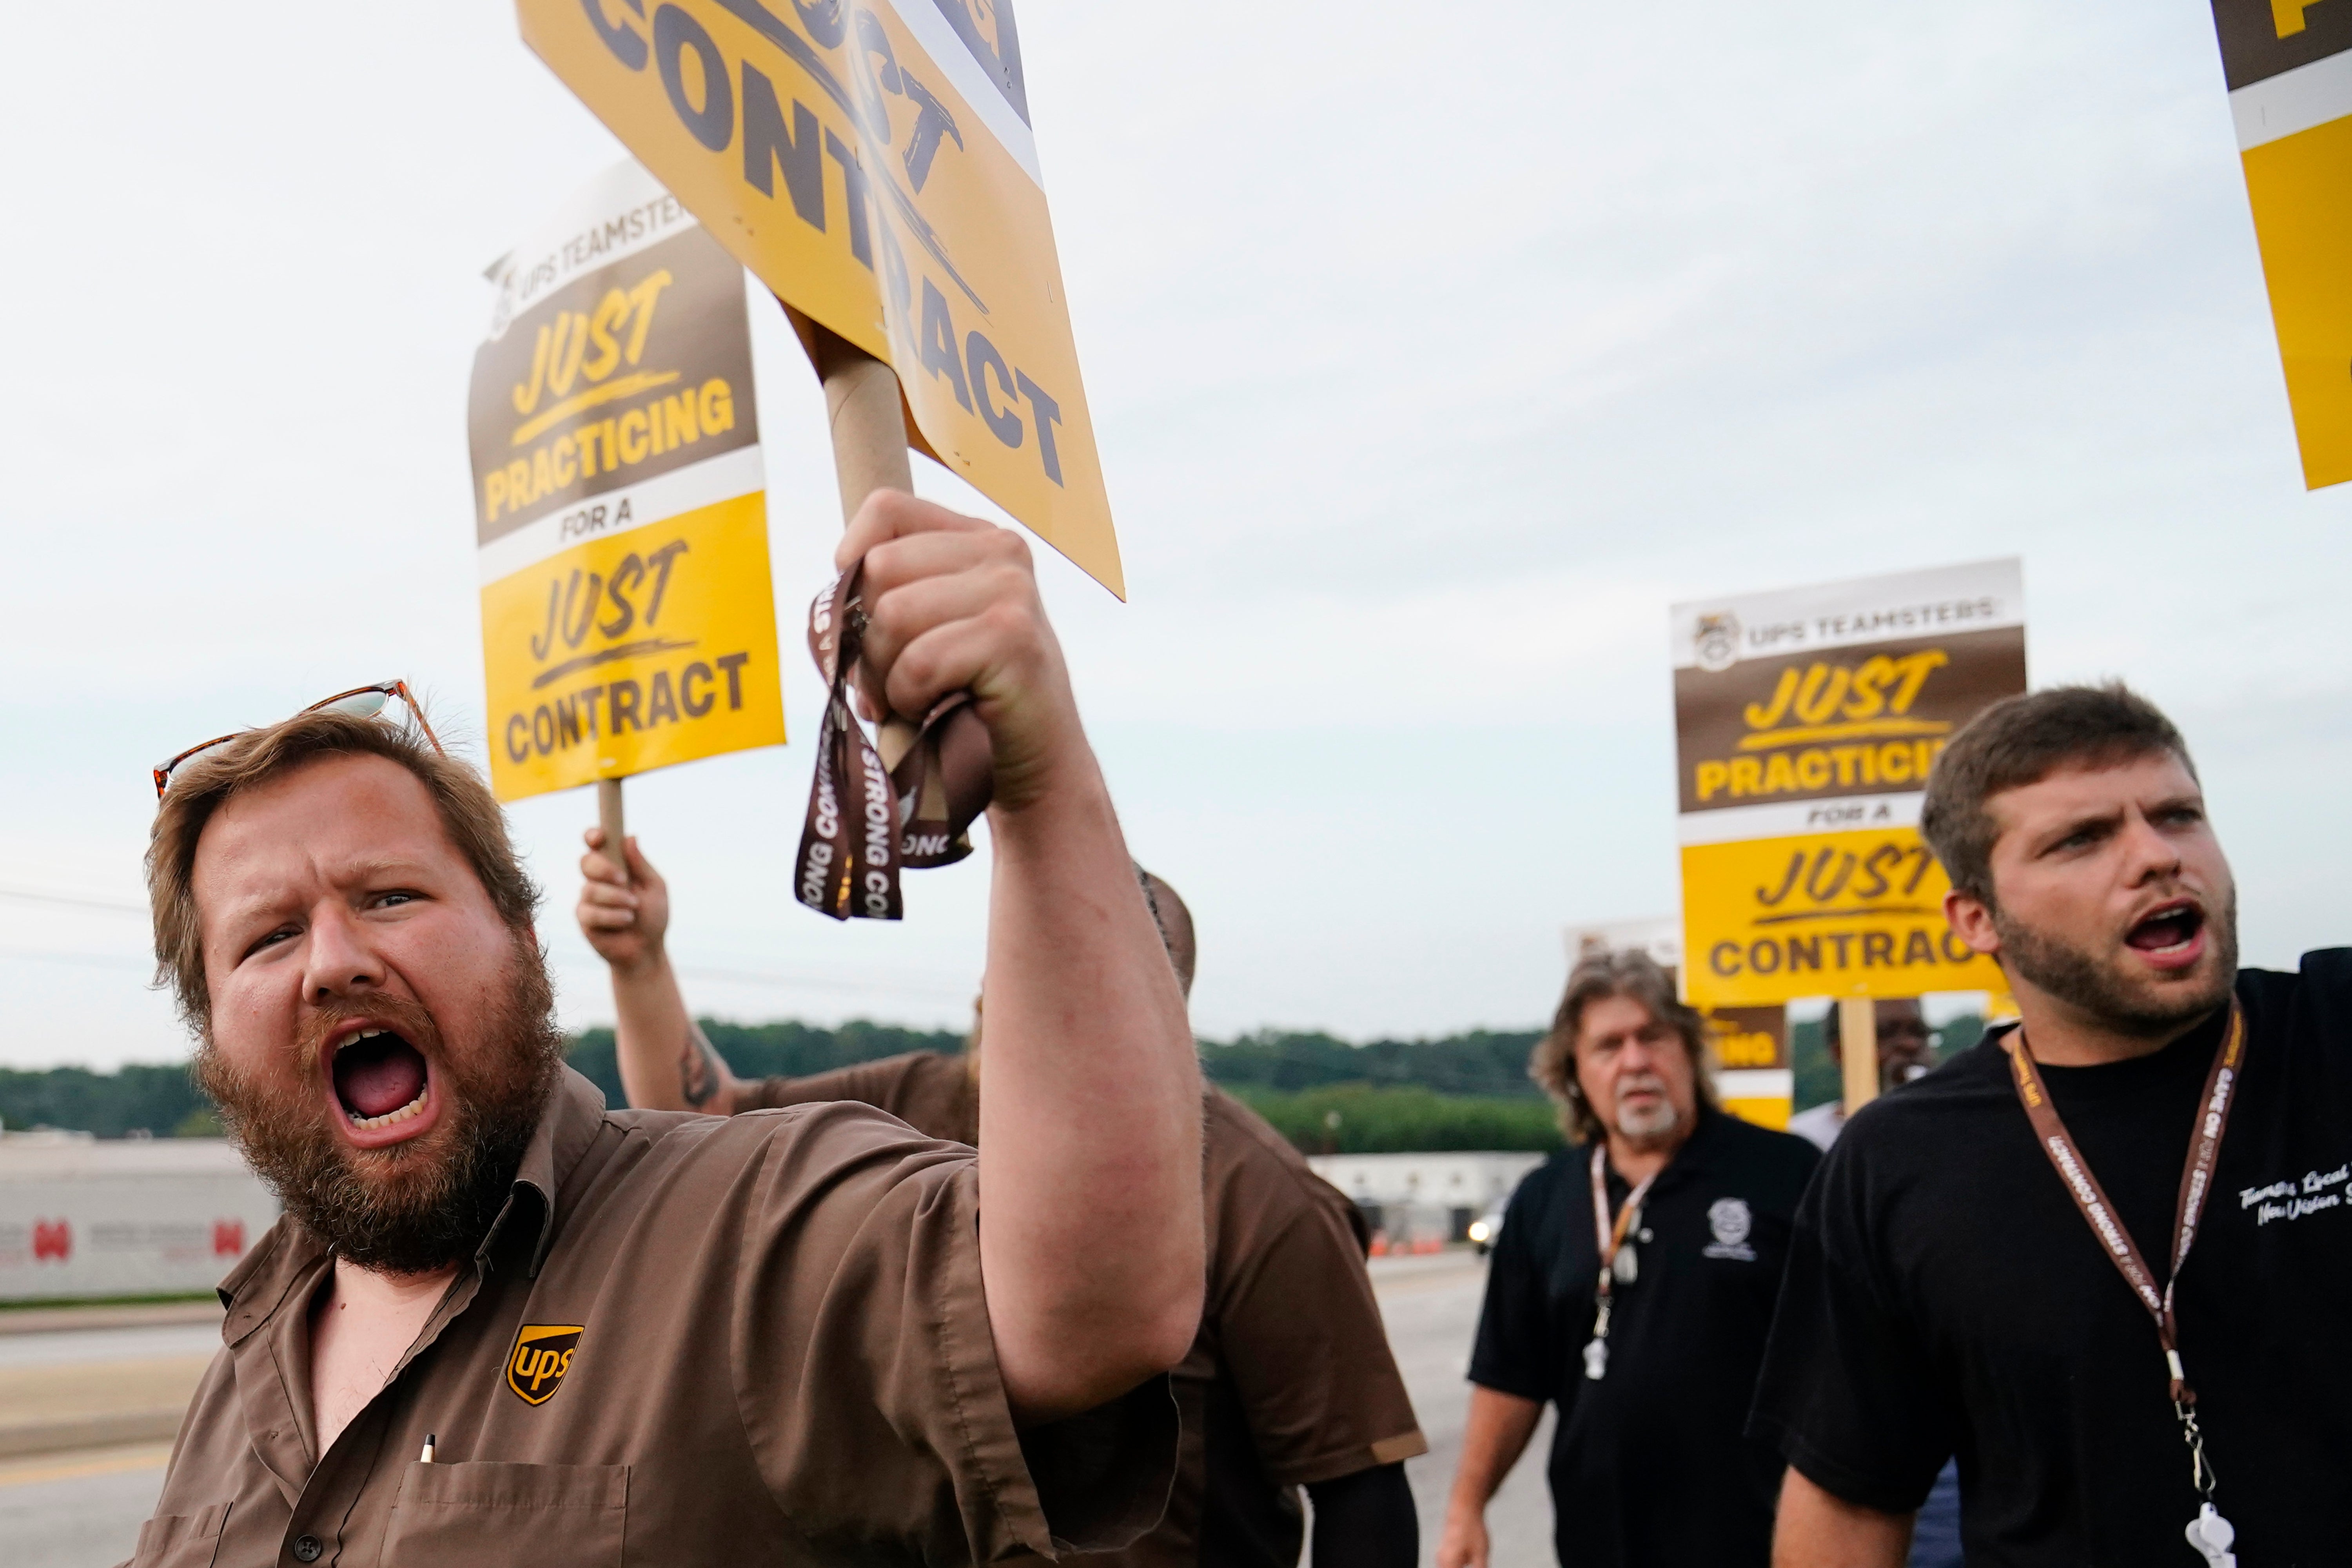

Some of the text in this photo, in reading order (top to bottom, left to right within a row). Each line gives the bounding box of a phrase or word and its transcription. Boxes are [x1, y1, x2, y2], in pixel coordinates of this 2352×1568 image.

[563, 192, 686, 272] TEAMSTE
[513, 269, 673, 415] JUST
[483, 377, 735, 522] PRACTICING
[561, 497, 632, 540] FOR A
[532, 539, 689, 662] JUST
[1748, 622, 1805, 647] UPS
[506, 652, 750, 765] CONTRACT
[1743, 648, 1949, 730] JUST
[1695, 738, 1944, 803] PRACTICI
[861, 747, 890, 867] STRONG
[1808, 805, 1890, 824] FOR A
[1756, 842, 1933, 906] JUST
[1709, 927, 1976, 978] CONTRAC
[515, 1346, 575, 1391] ups
